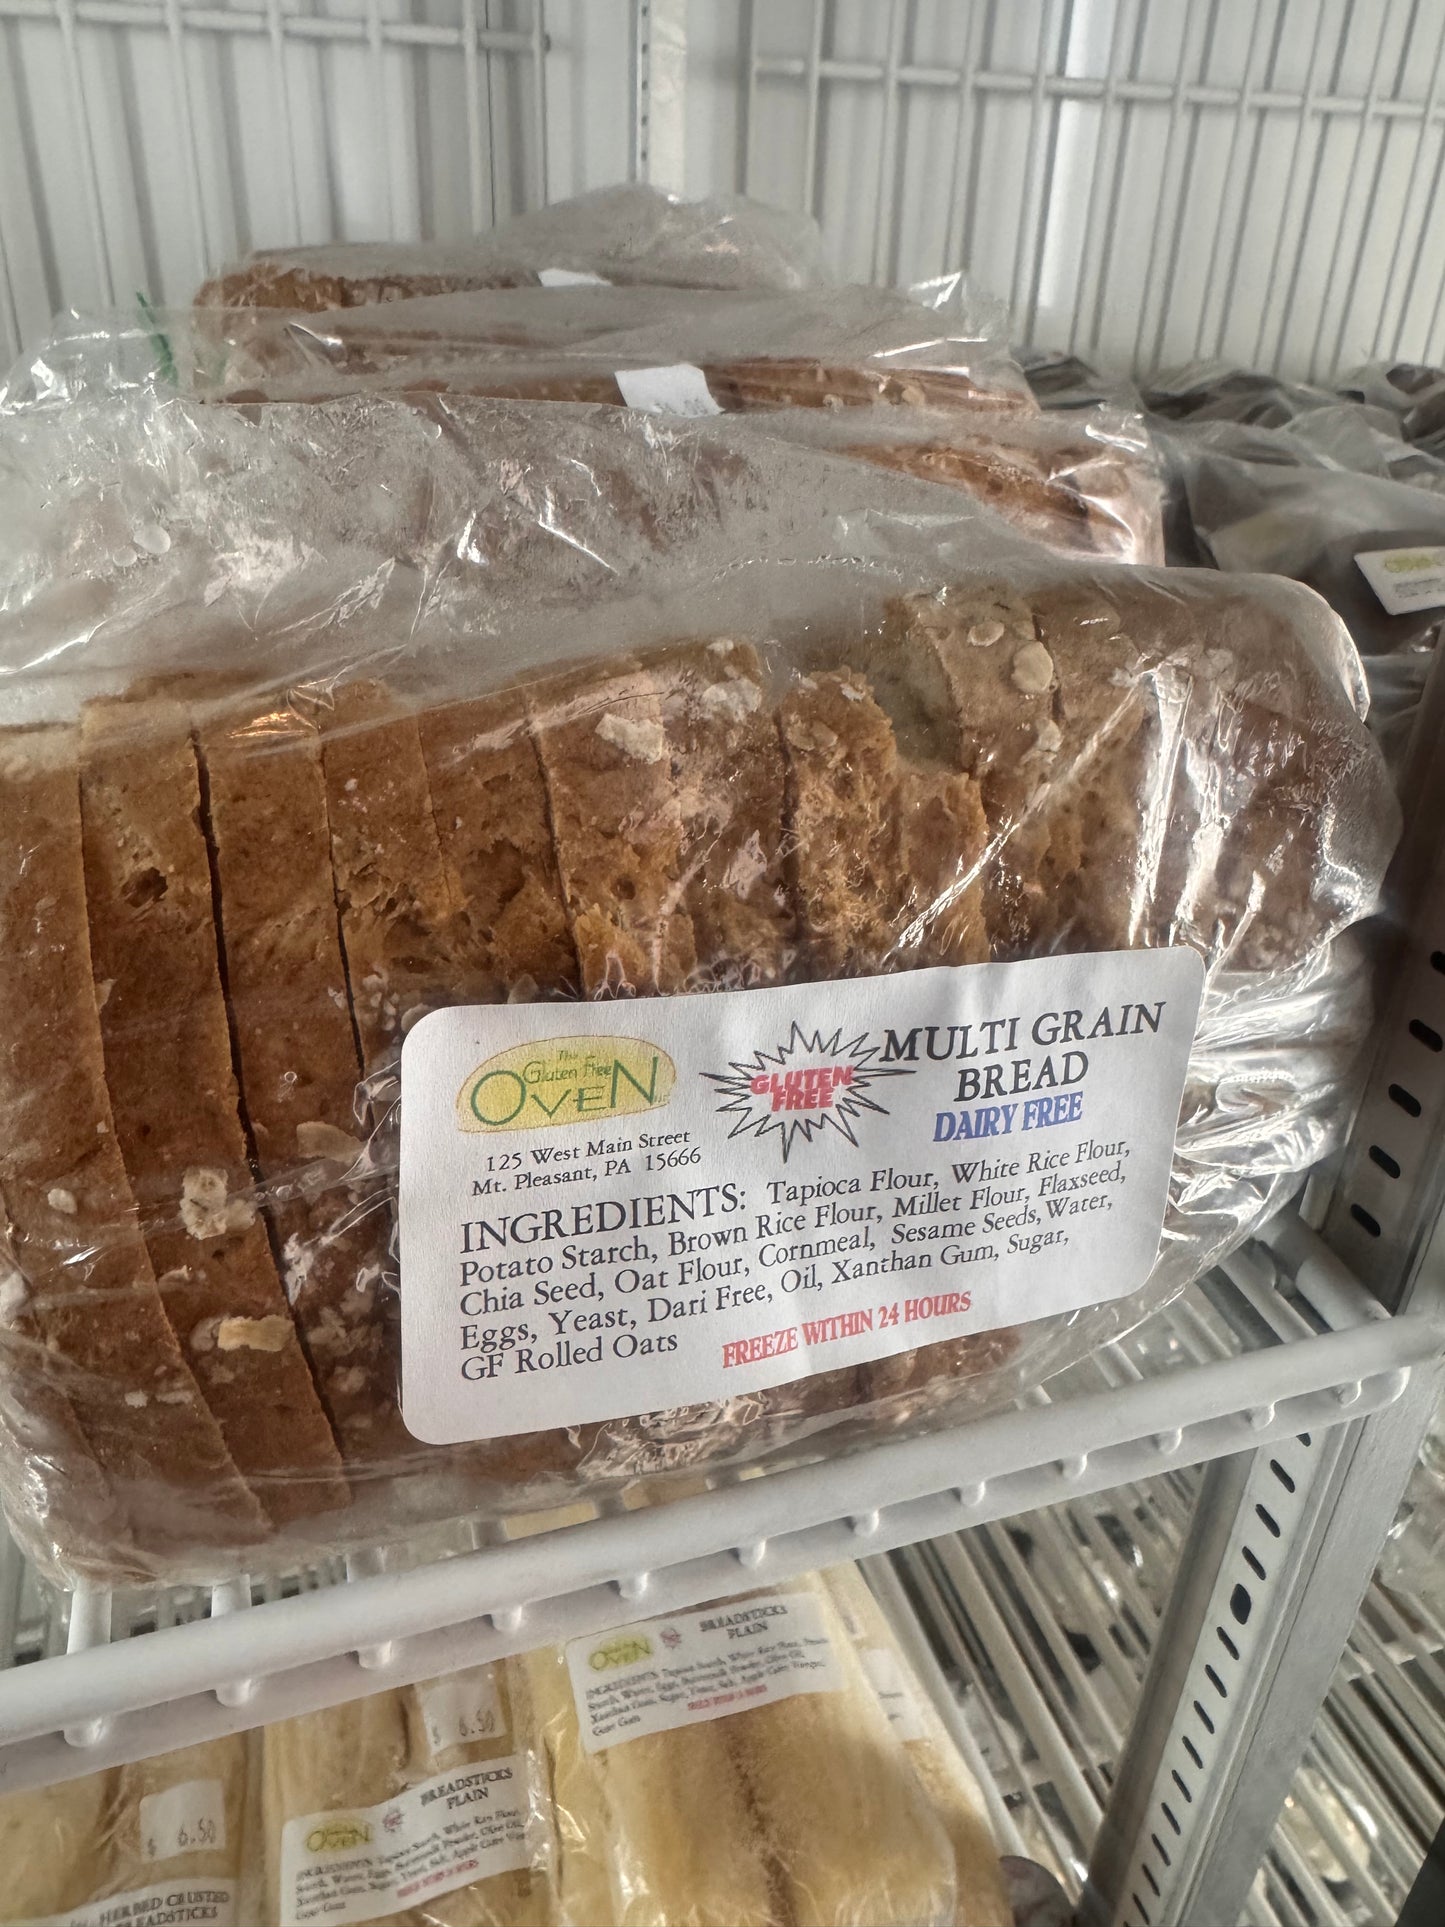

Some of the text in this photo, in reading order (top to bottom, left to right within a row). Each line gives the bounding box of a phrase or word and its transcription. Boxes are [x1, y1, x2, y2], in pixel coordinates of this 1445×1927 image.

[879, 1001, 1167, 1063] MULTI GRAIN
[522, 1054, 613, 1085] Gluten Free
[749, 1065, 855, 1095] GLUTEN
[953, 1050, 1089, 1102] BREAD
[771, 1086, 835, 1113] FREE
[932, 1091, 1084, 1143] DAIRY FREE
[472, 1146, 702, 1197] Mt. Pleasant, PA 15666
[487, 1130, 691, 1173] 125 West Main Street
[460, 1139, 1131, 1254] INGREDIENTS: Tapioca Flour, White Rice Flour,
[460, 1160, 1127, 1287] Potato Starch, Brown Rice Flour, Millet Flour, Flaxseed,
[460, 1193, 1113, 1317] Chia Seed, Oat Flour, Cornmeal, Sesame Seeds, Water,
[460, 1228, 1070, 1354] Eggs, Yeast, Dari Free, Oil, Xanthan Gum, Sugar,
[722, 1290, 973, 1369] FREEZE WITHIN 24 HOURS
[461, 1333, 679, 1382] GF Rolled Oats
[420, 1767, 513, 1806] BREADSTICKS
[447, 1787, 489, 1809] PLAIN
